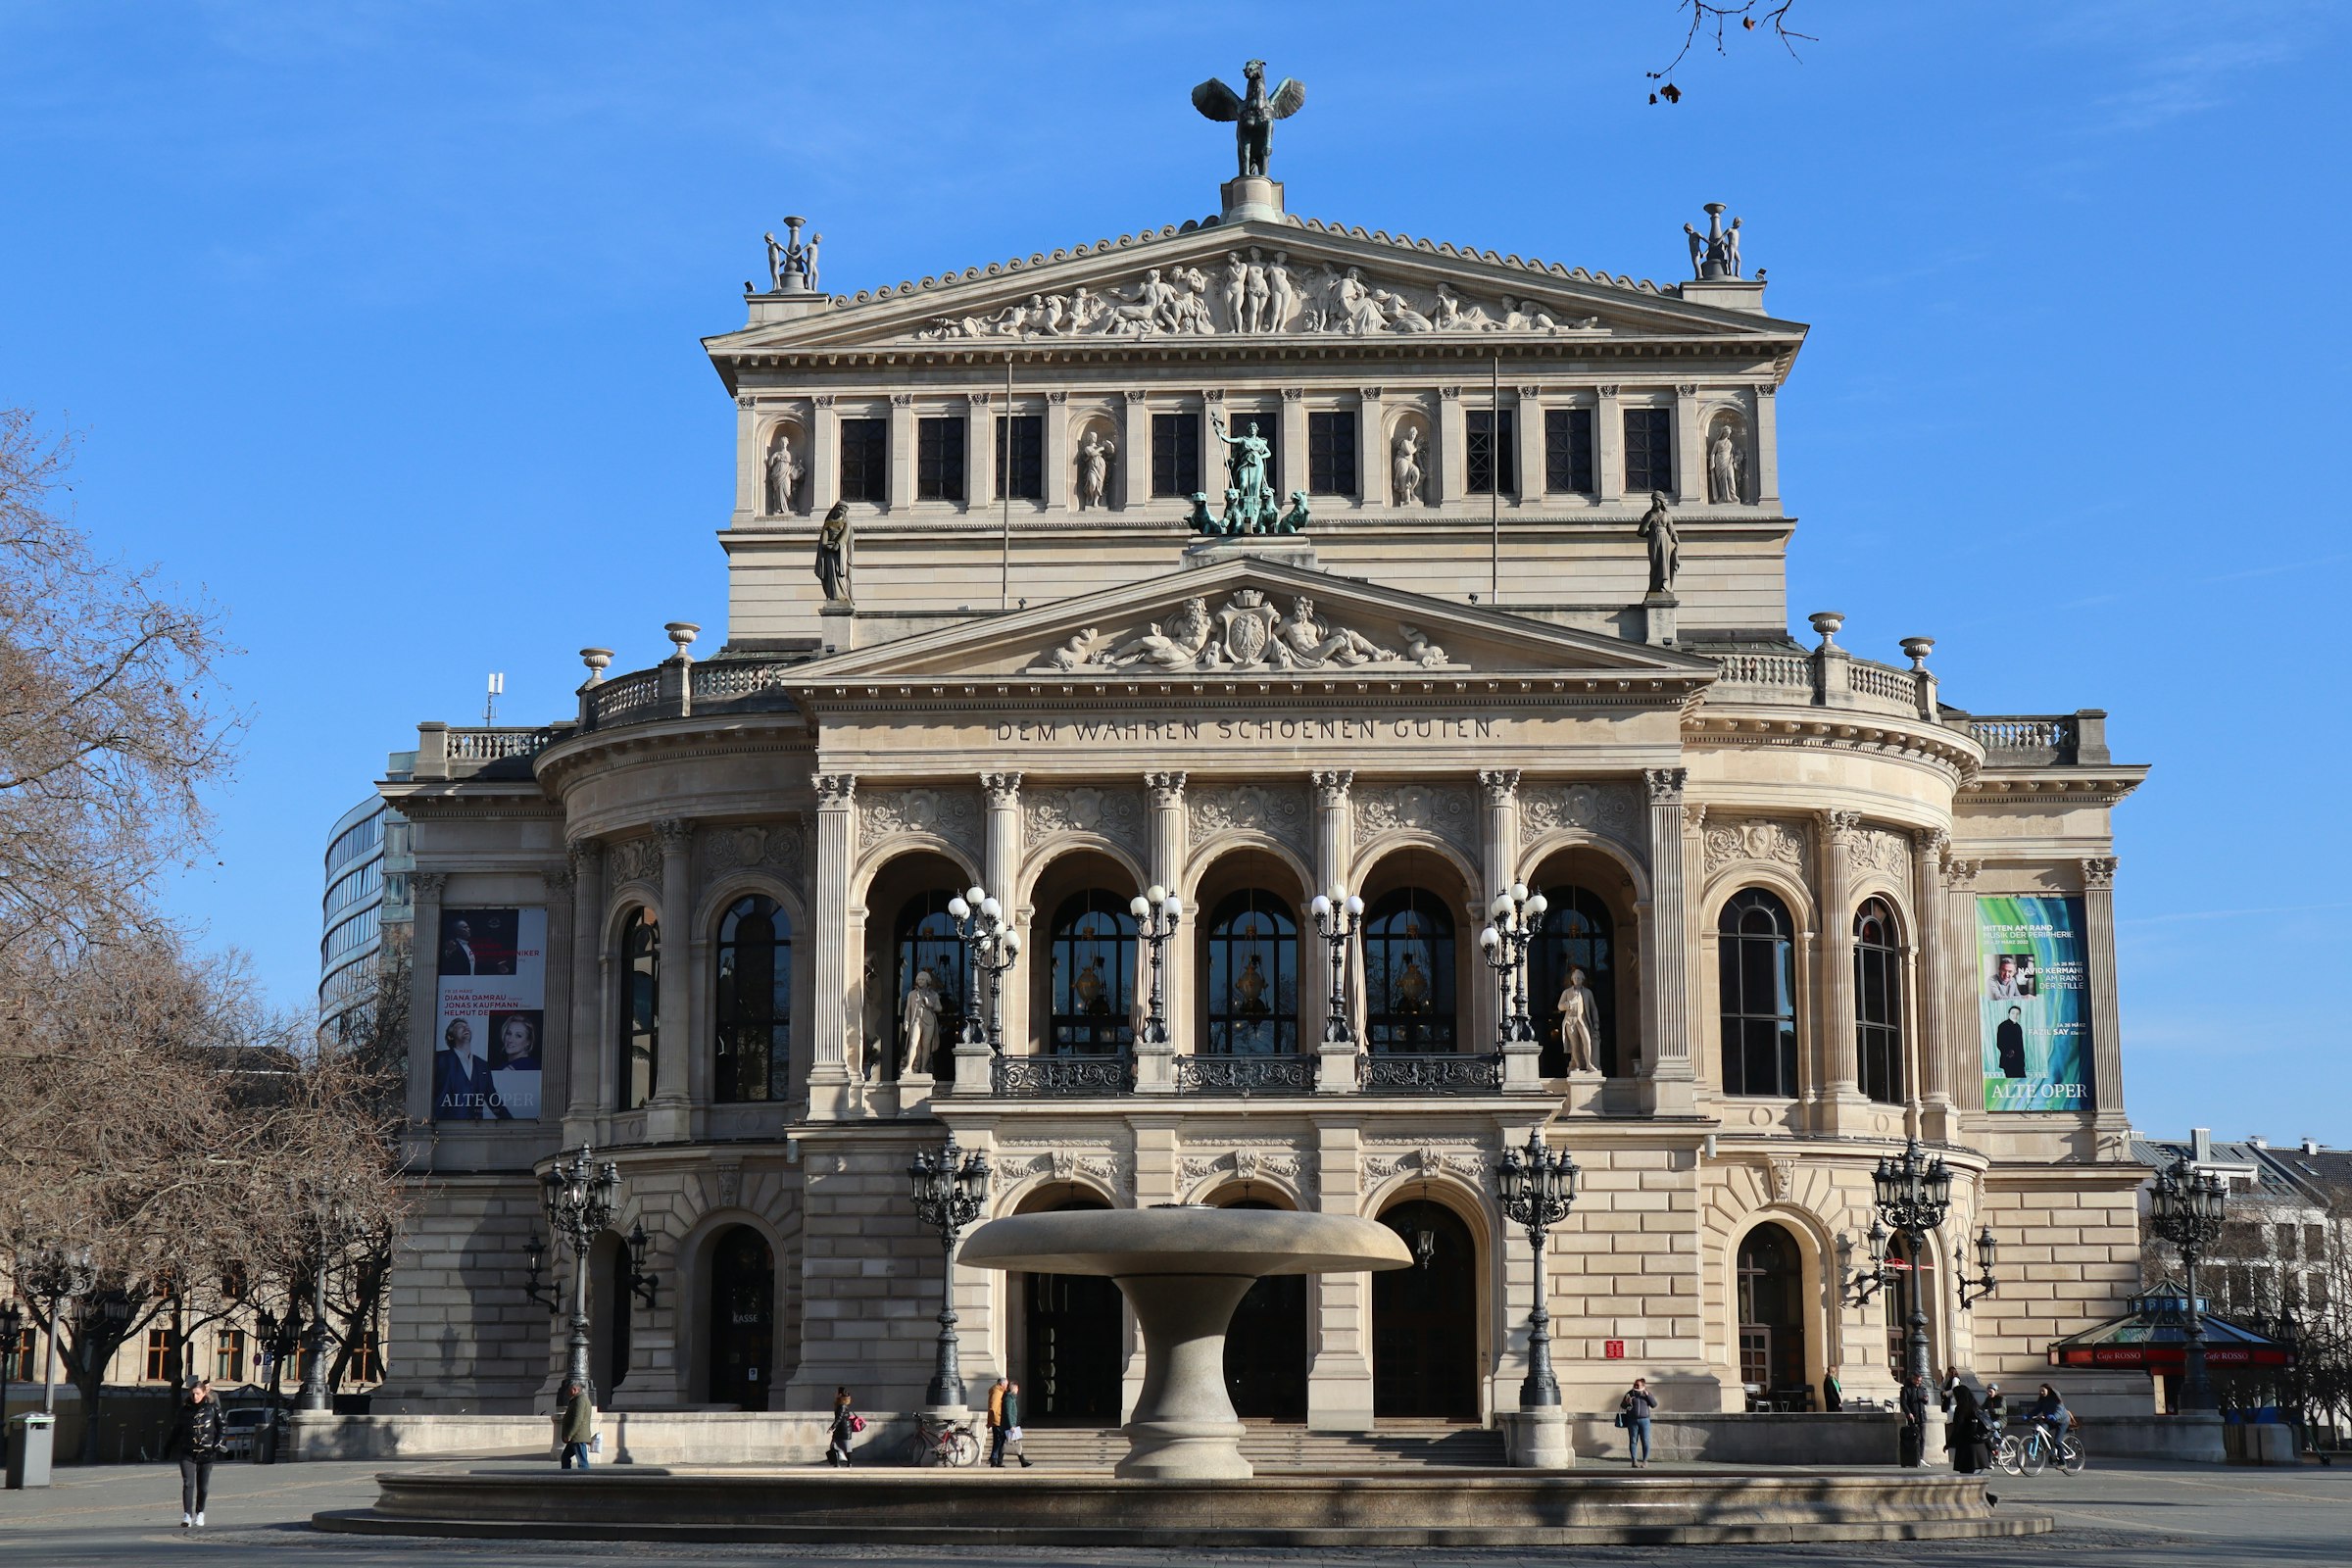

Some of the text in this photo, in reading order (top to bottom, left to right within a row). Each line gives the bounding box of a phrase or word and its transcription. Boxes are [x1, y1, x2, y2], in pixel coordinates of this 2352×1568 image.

[997, 716, 1501, 743] DEM WAHREN SCHOENEN GUTEN.
[1991, 1084, 2087, 1098] ALTE OPER
[440, 1093, 534, 1107] ALTE OPER
[733, 1312, 758, 1323] KASSE
[2114, 1351, 2141, 1360] ROSSO
[2222, 1351, 2249, 1360] ROSSO
